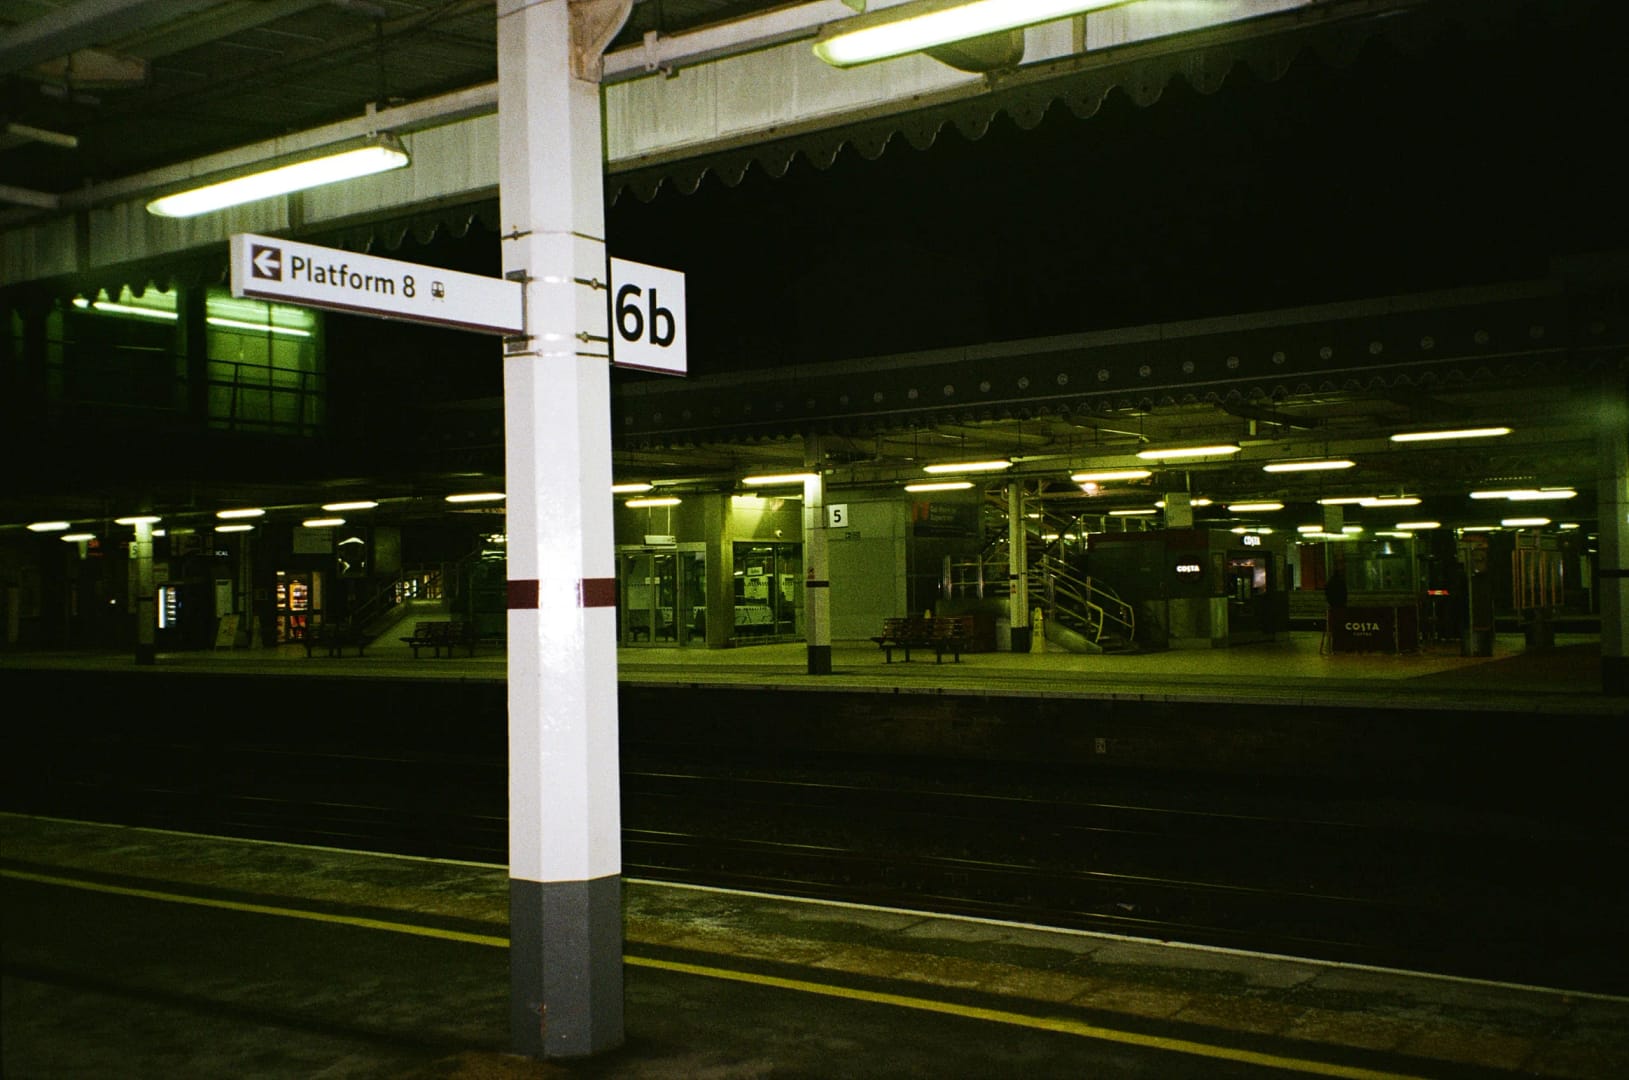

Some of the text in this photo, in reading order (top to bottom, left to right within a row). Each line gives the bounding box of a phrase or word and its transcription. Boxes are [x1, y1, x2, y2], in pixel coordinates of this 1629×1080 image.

[291, 255, 416, 298] Platform 8
[615, 284, 676, 348] 6b
[834, 509, 842, 523] 5
[1176, 564, 1200, 573] COSTA
[1344, 622, 1380, 632] COSTA
